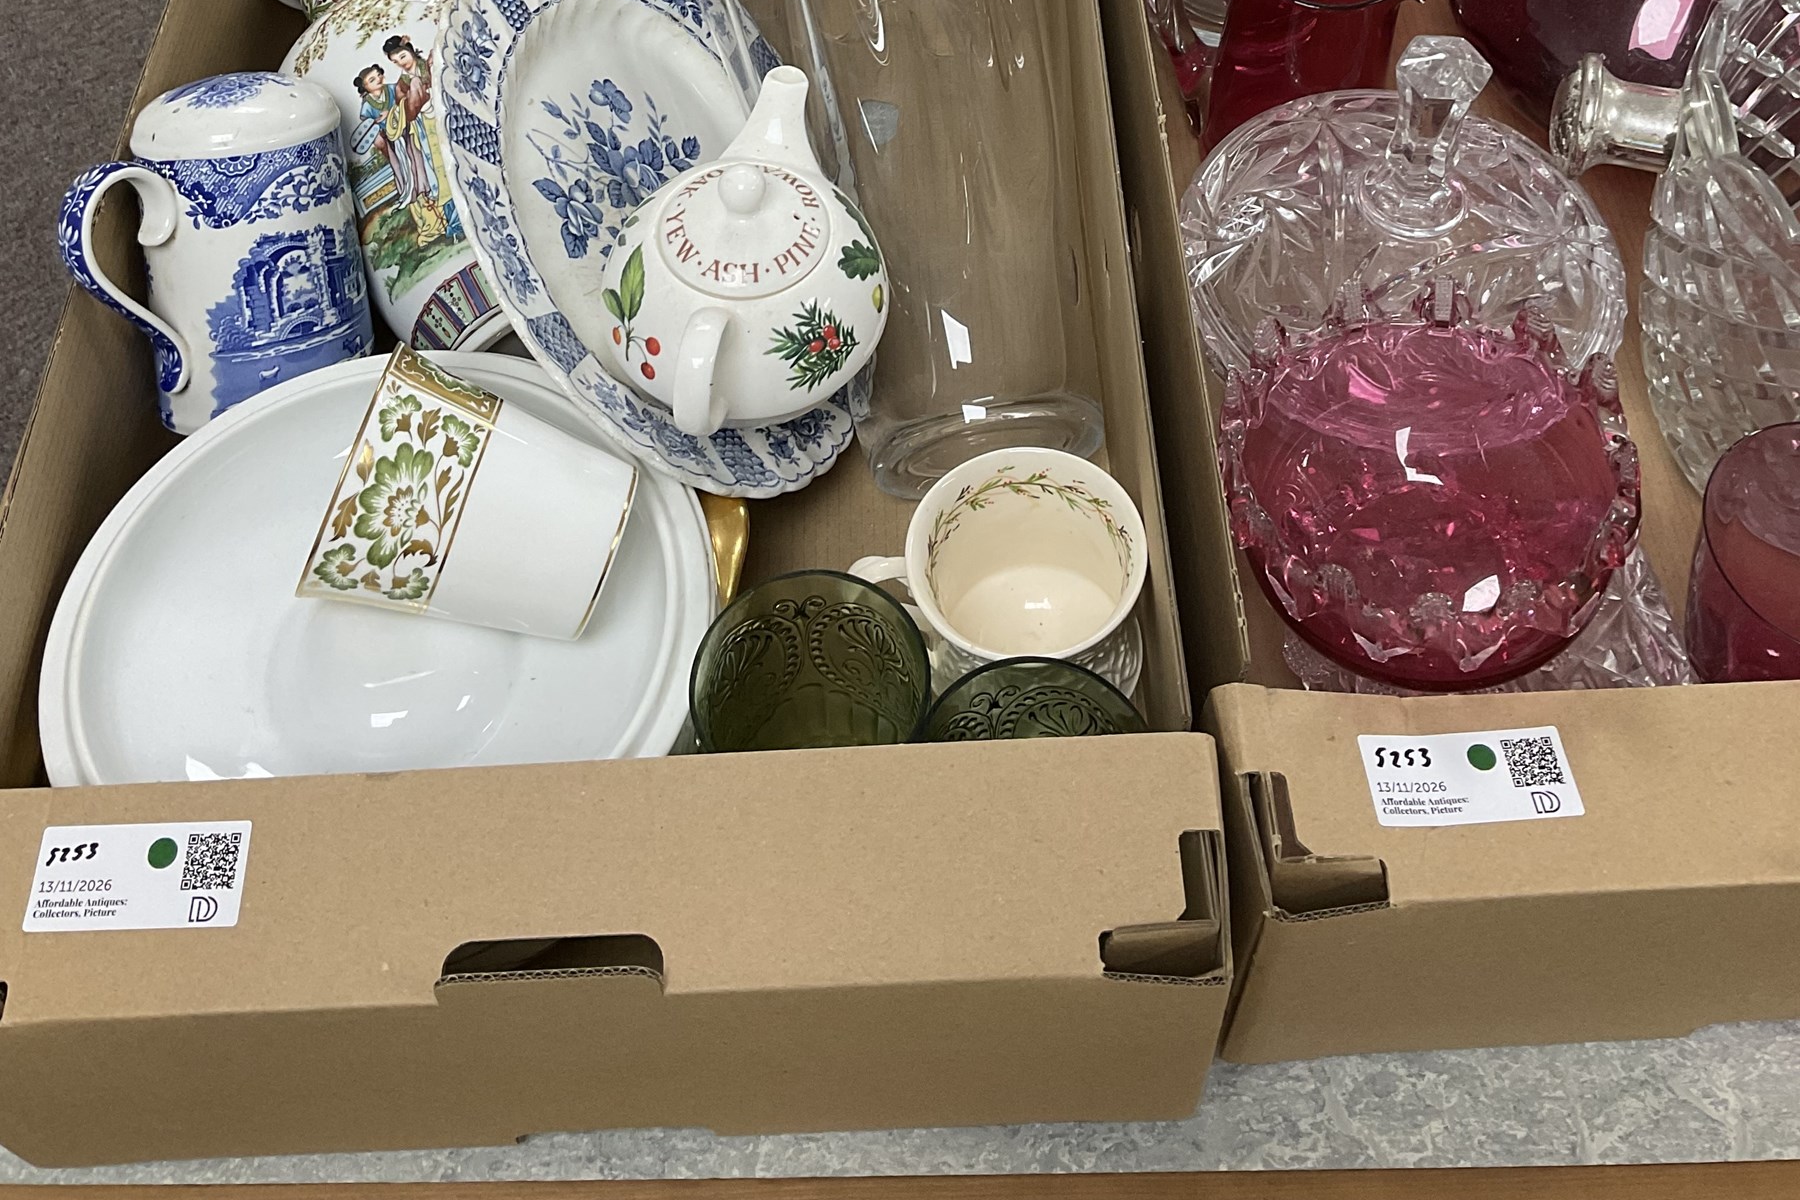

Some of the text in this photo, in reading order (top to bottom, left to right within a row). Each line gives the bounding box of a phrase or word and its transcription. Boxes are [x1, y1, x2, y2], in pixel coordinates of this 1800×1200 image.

[677, 168, 725, 199] OAK
[755, 165, 820, 209] ROWA
[666, 208, 821, 284] YEW ASH PINE
[1375, 747, 1432, 769] 5253
[1377, 781, 1447, 794] 13/11/2026
[1381, 796, 1470, 806] Affordable Antiques:
[1383, 805, 1463, 815] Collectors, Picture
[45, 842, 100, 867] 5253
[38, 879, 113, 894] 13/11/2026
[34, 898, 129, 909] Affordable Antiques:
[32, 908, 117, 919] Collectors, Picture
